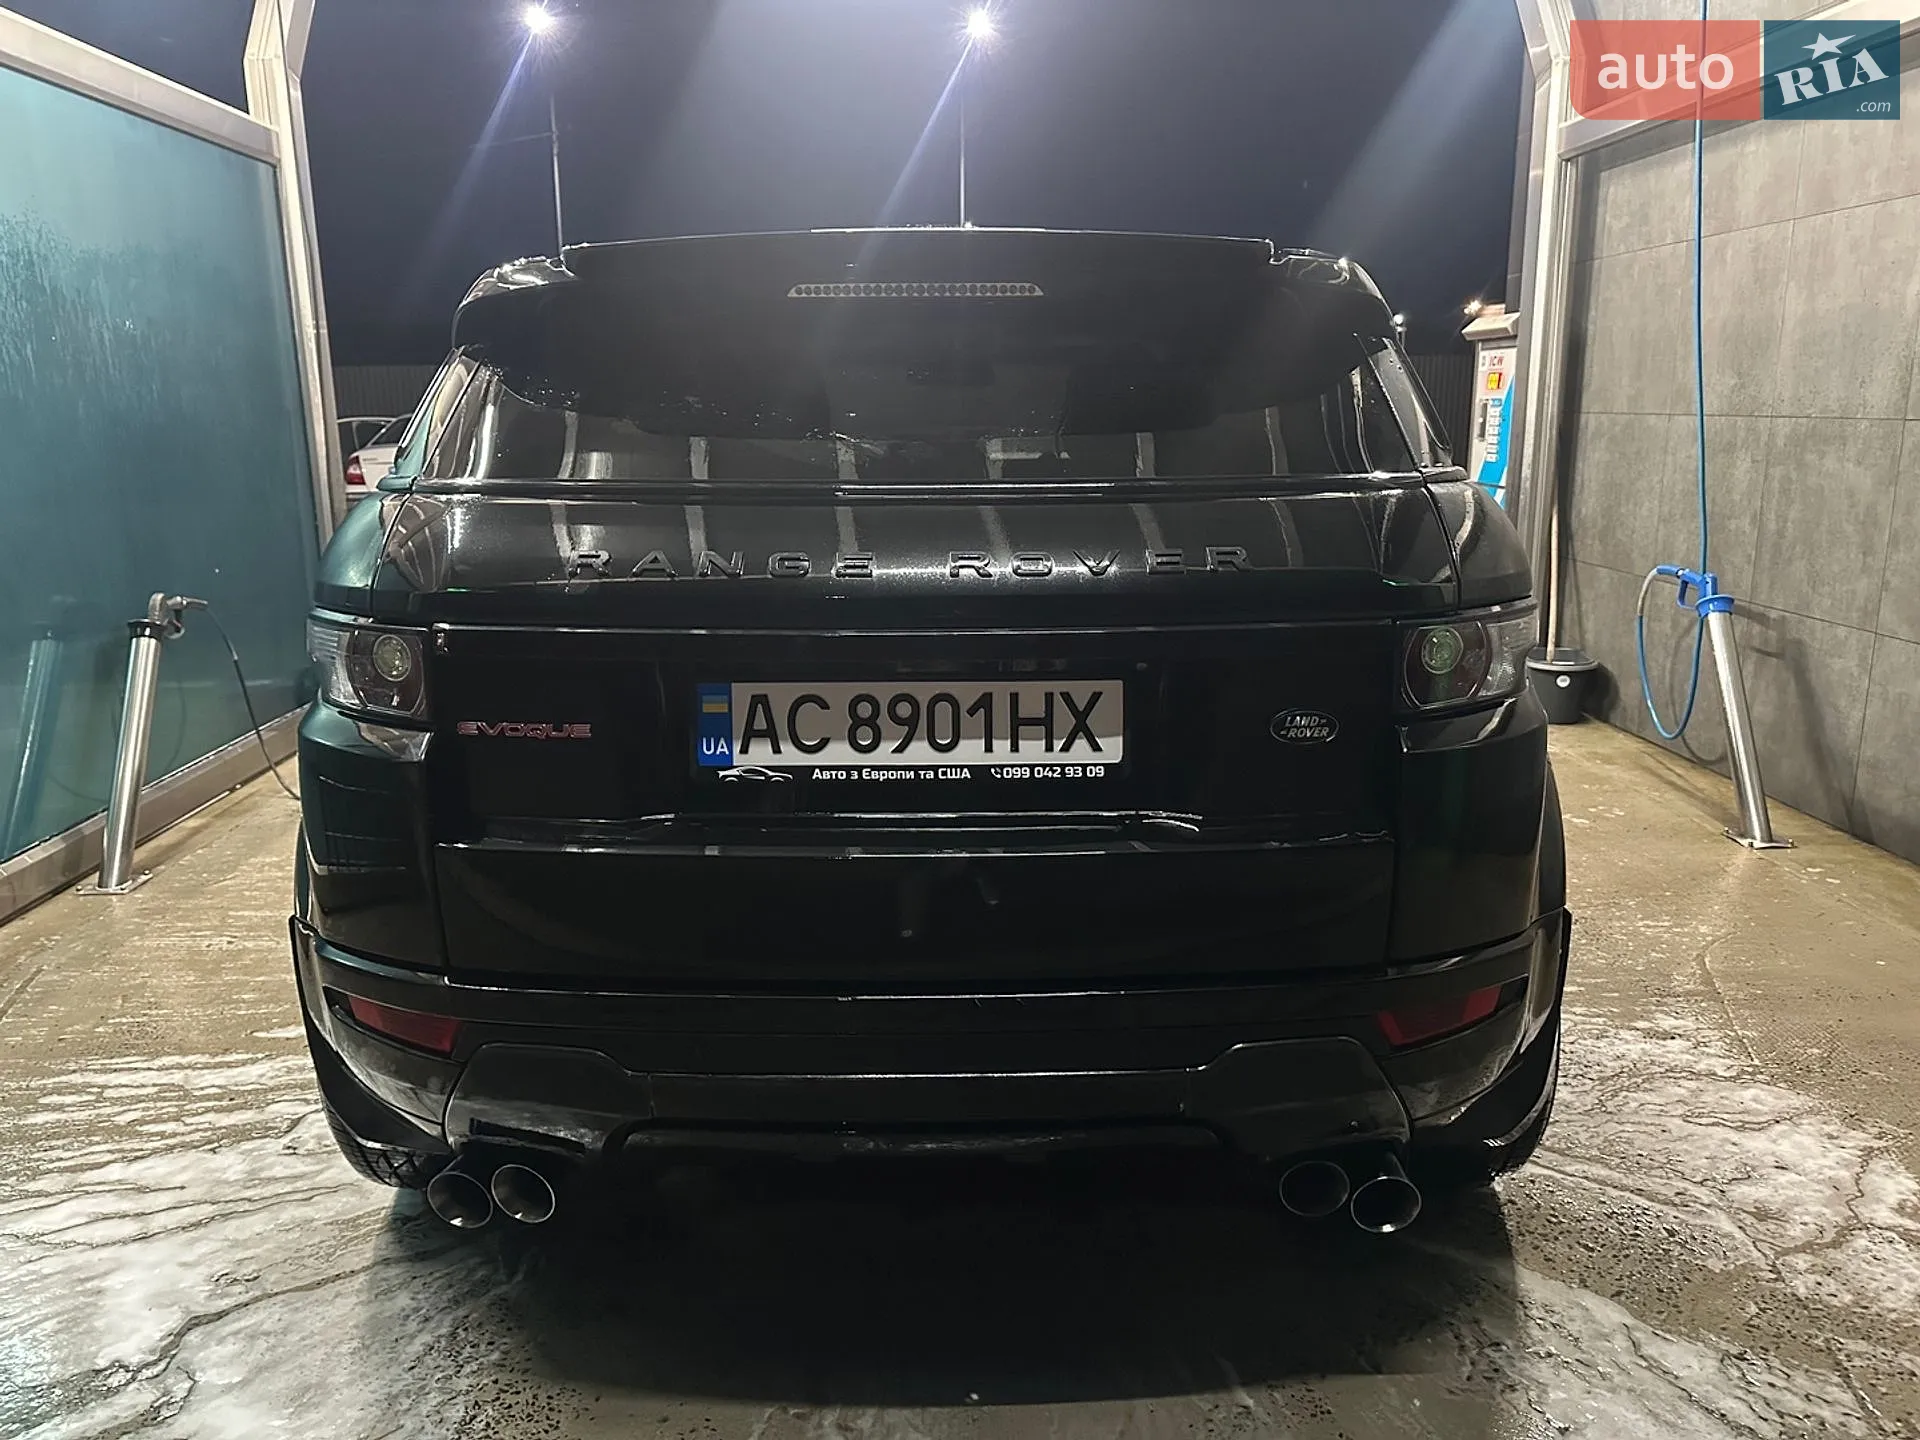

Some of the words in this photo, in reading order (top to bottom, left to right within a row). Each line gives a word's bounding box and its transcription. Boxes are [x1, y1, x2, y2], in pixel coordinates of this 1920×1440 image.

[568, 550, 874, 579] RANGE
[949, 546, 1254, 579] ROVER
[456, 721, 592, 740] EVOQUE
[738, 693, 831, 755] AC
[702, 738, 729, 755] UA
[812, 768, 846, 779] Авто
[850, 770, 858, 779] з
[862, 768, 915, 781] Європи
[918, 770, 934, 779] та
[938, 768, 971, 779] США
[1003, 767, 1030, 778] 099
[1034, 767, 1061, 778] 042
[1065, 766, 1082, 777] 93
[1086, 766, 1105, 777] 09
